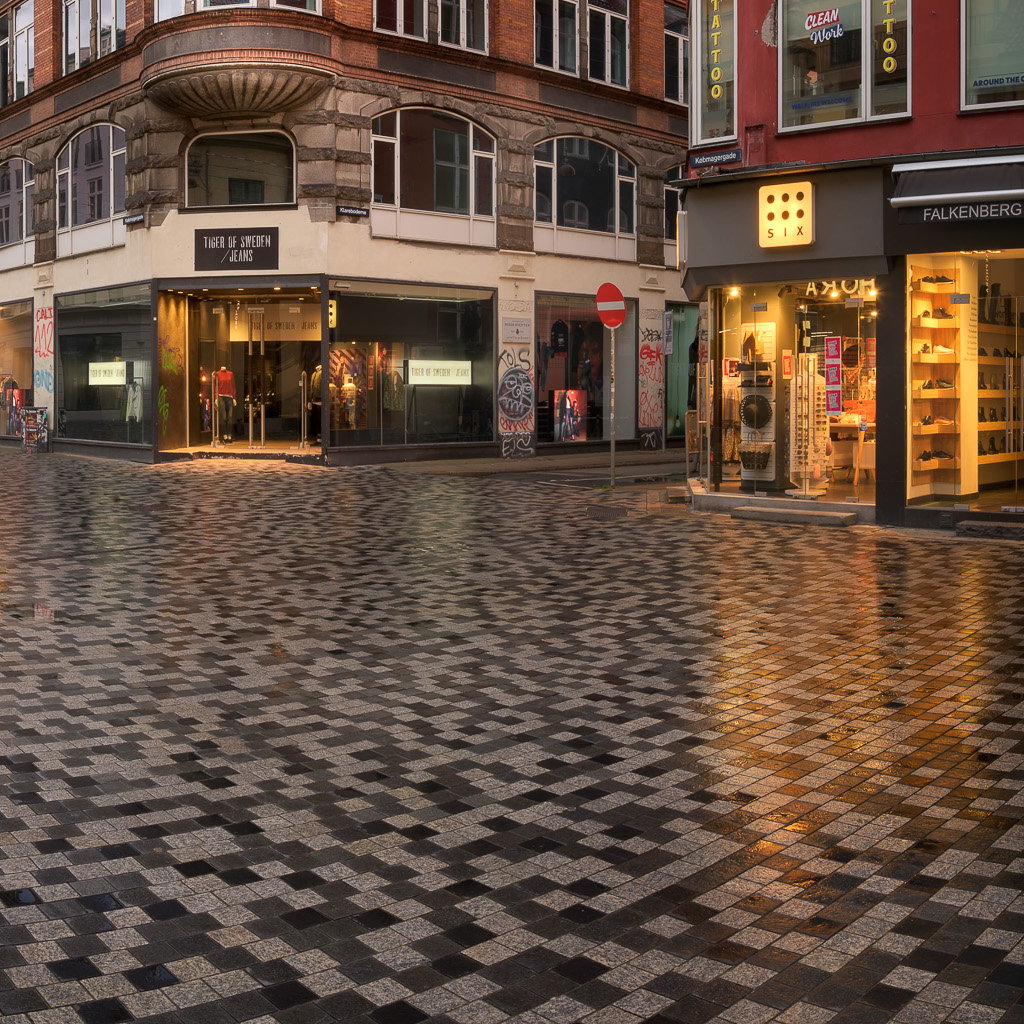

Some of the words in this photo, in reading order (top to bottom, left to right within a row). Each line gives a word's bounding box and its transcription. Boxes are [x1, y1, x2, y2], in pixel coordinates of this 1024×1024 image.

[805, 8, 839, 31] CLEAN
[810, 24, 843, 45] Work
[972, 77, 1004, 88] AROUND
[1005, 75, 1020, 84] THE
[923, 202, 1022, 221] FALKENBERG
[767, 226, 804, 238] SIX
[203, 236, 225, 249] TIGER
[228, 236, 237, 249] OF
[240, 235, 271, 248] SWEDEN
